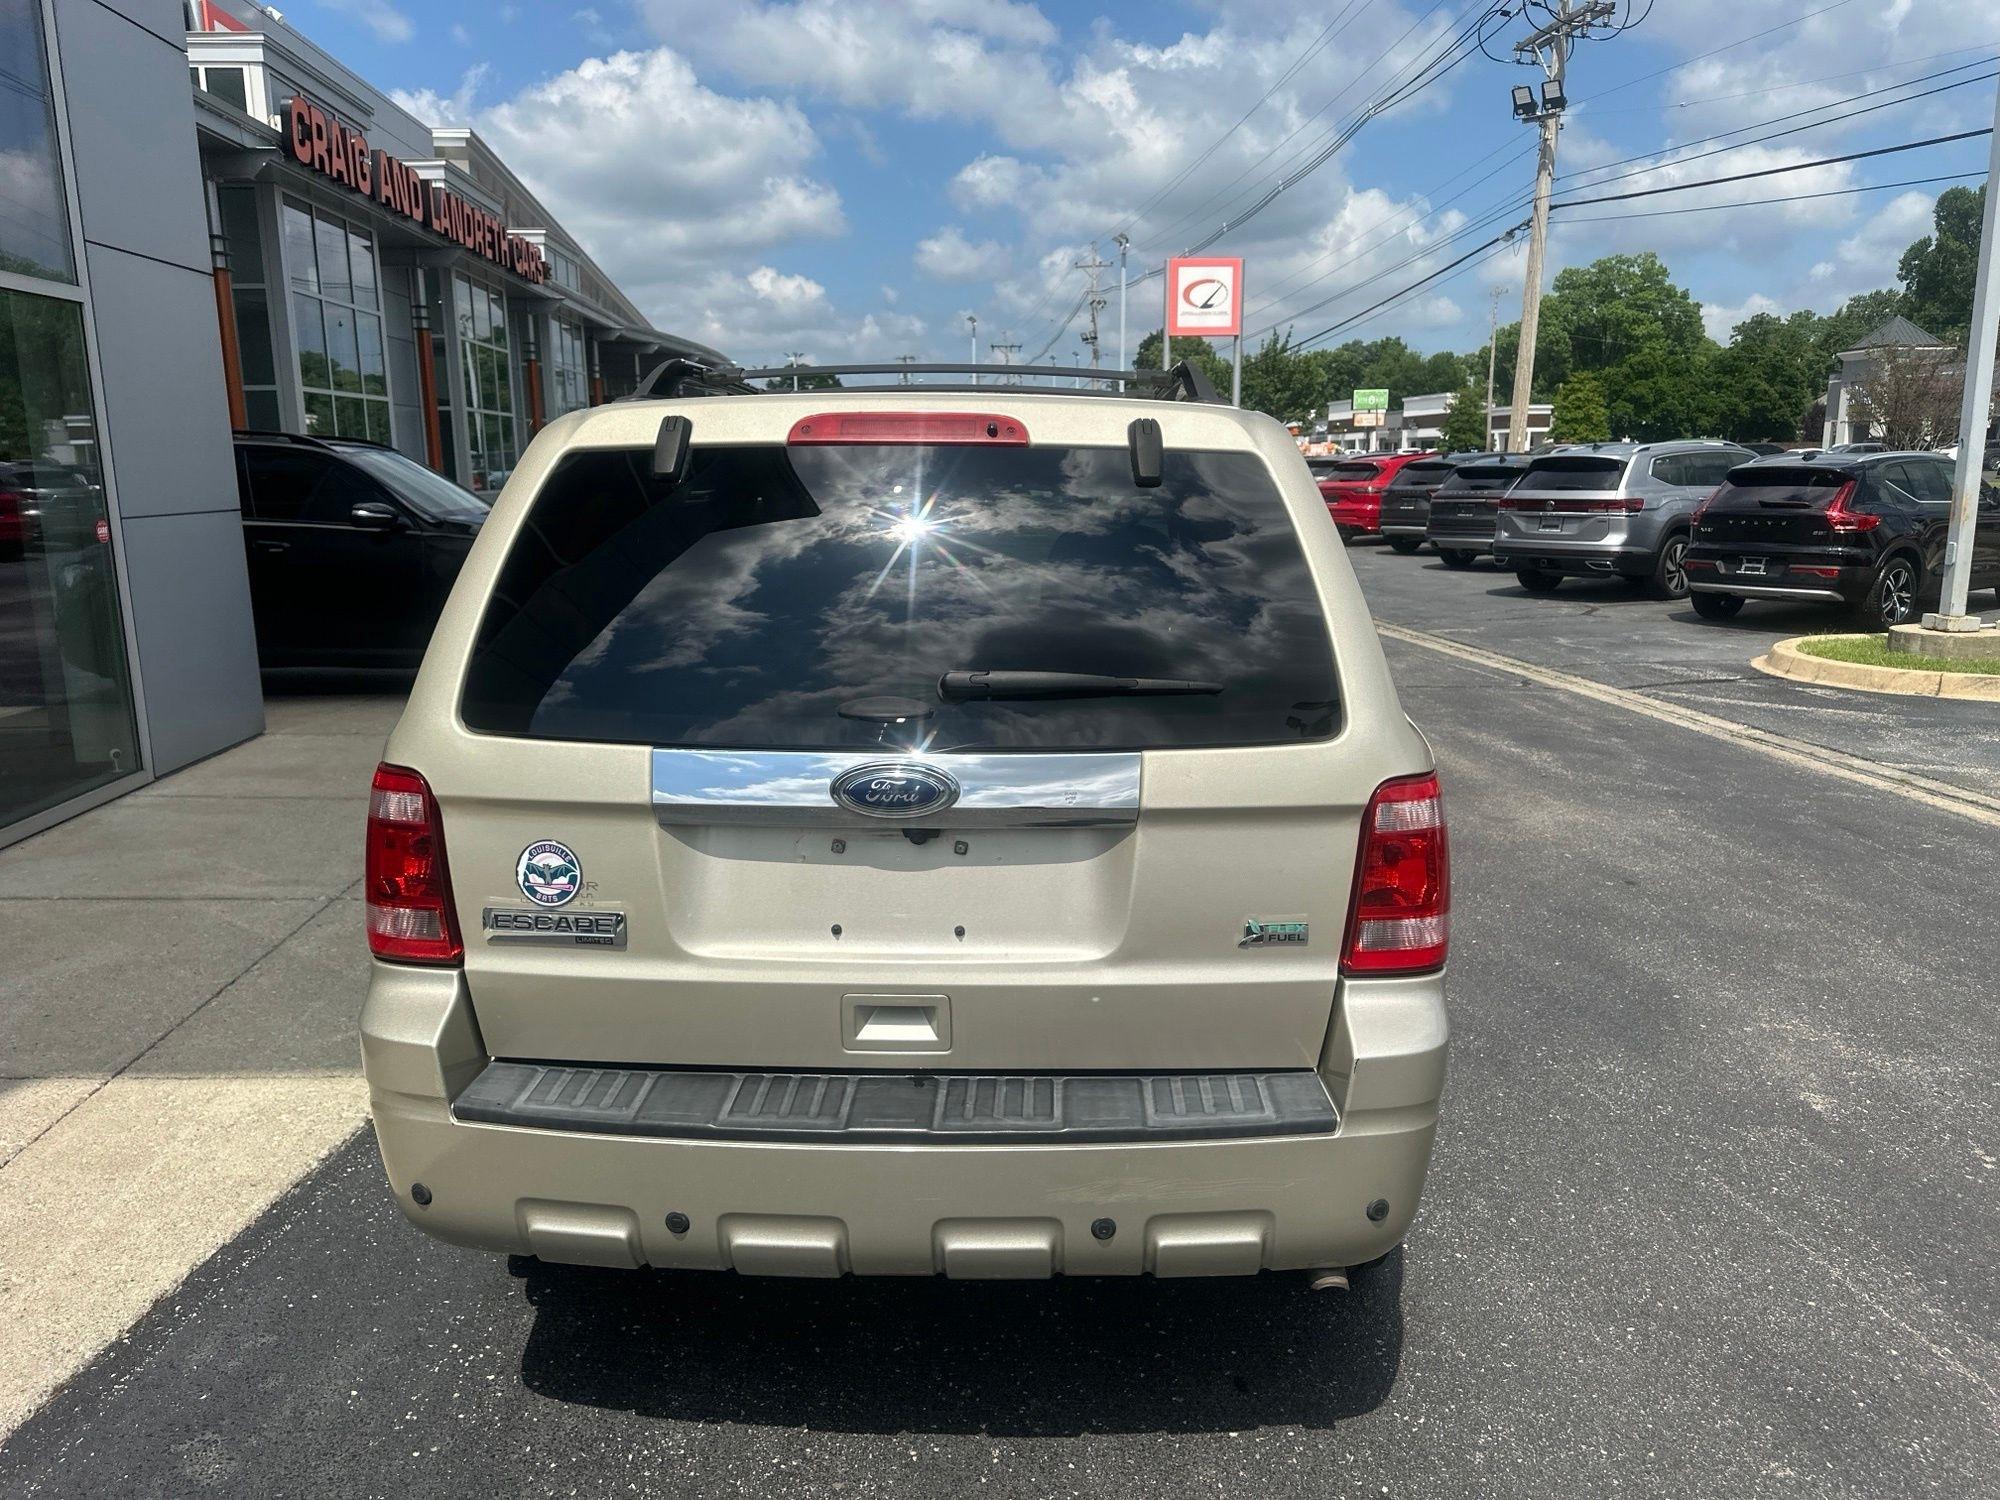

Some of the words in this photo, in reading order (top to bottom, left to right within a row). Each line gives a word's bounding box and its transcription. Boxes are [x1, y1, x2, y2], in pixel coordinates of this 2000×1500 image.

[290, 95, 372, 197] CRAIG
[380, 149, 424, 222] AND
[429, 182, 511, 267] LANDRETH
[513, 234, 545, 285] CARS
[865, 779, 920, 803] Ford
[529, 844, 572, 862] LOUISVILLE
[535, 892, 558, 902] BATS
[493, 913, 614, 934] ESCAPE
[576, 937, 613, 945] LIMITED
[1268, 933, 1306, 942] FUEL
